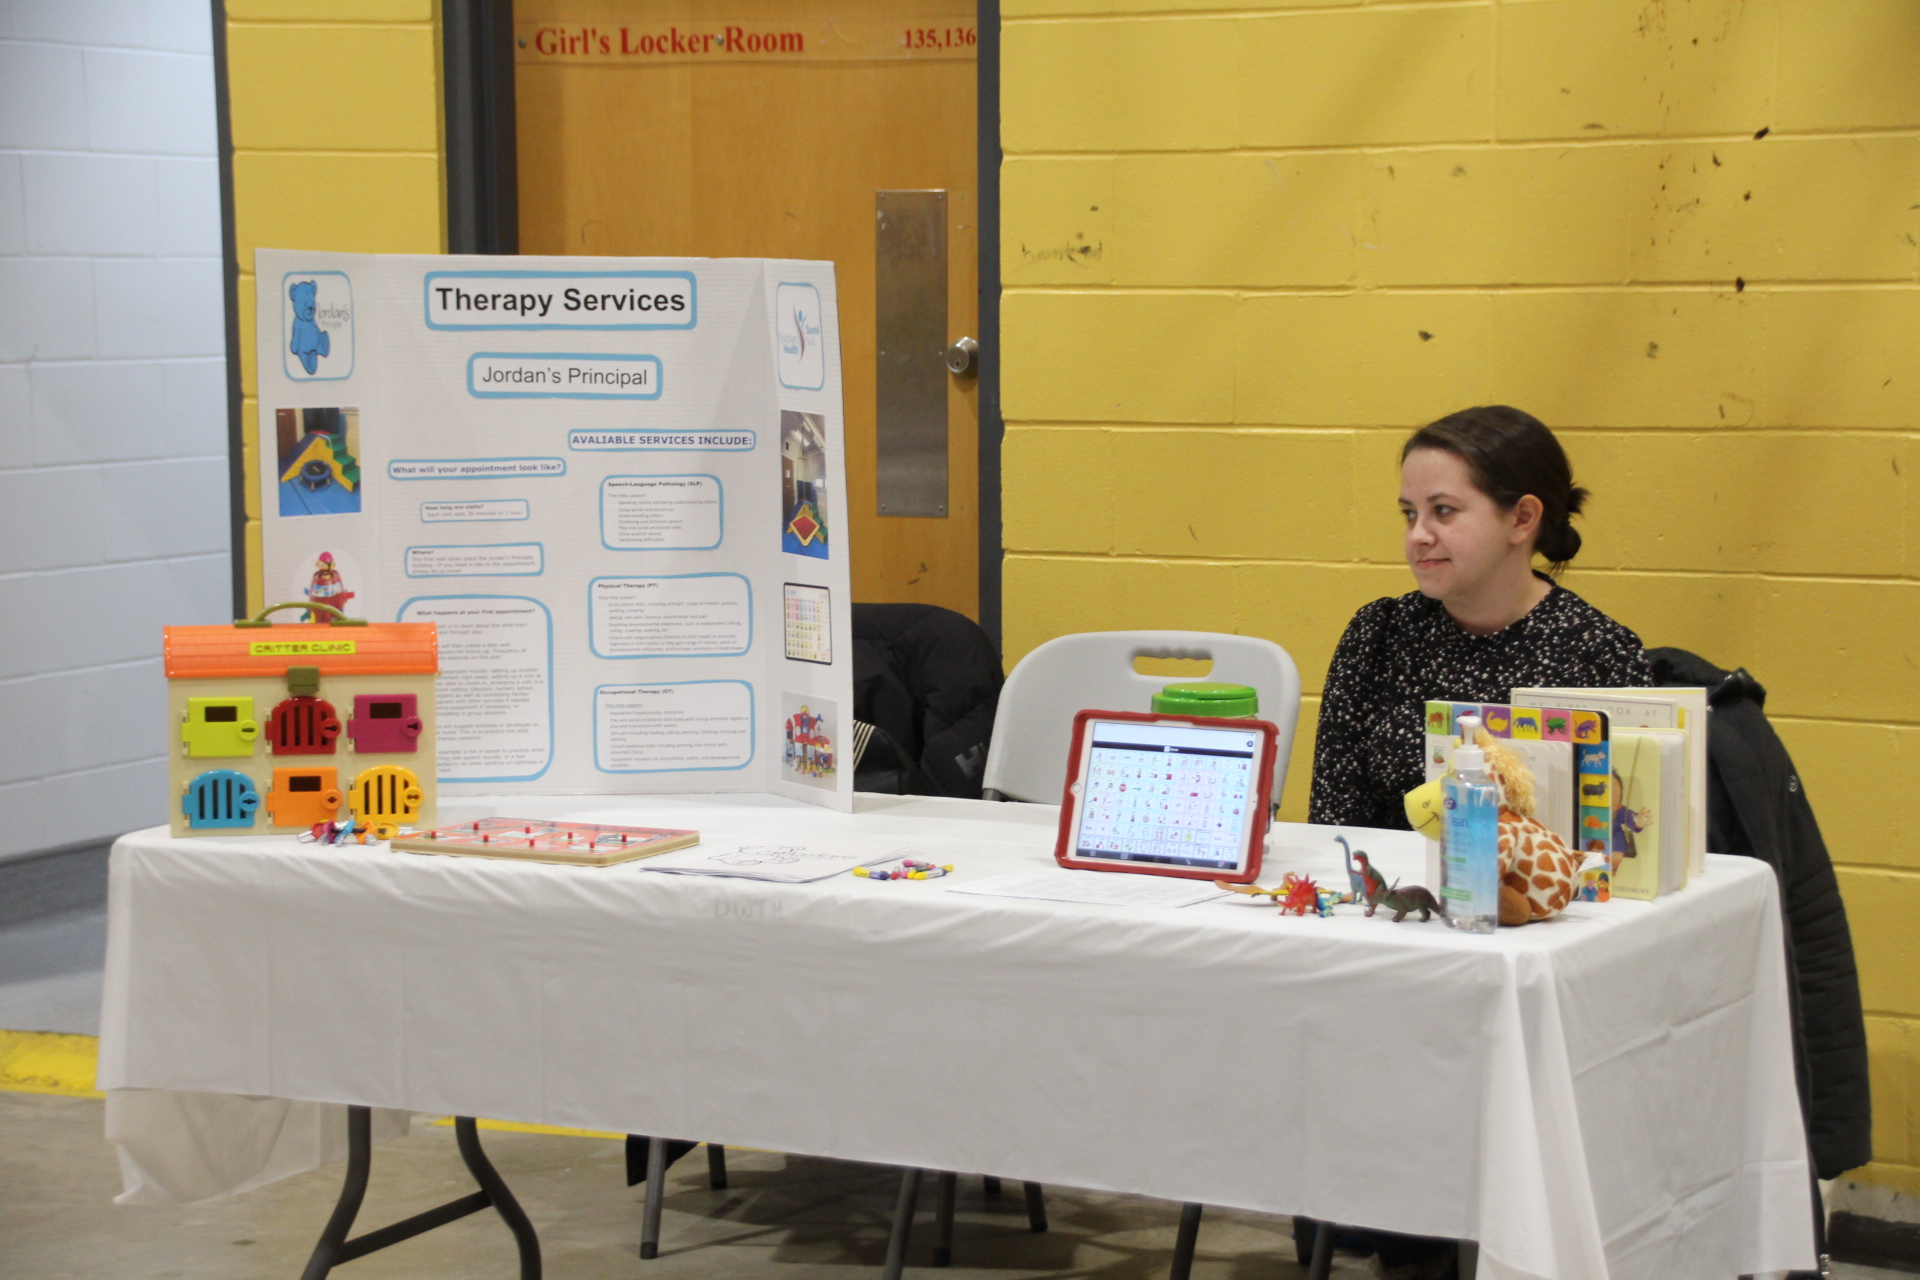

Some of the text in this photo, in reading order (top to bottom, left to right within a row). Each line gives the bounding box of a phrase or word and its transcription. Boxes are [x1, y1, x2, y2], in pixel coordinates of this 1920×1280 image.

[536, 26, 977, 55] Girl's Locker Room 135,136
[435, 287, 685, 317] Therapy Services
[482, 366, 647, 388] Jordan's Principal
[572, 435, 753, 446] AVALIABLE SERVICES INCLUDE:
[392, 466, 416, 474] What
[437, 467, 457, 475] your
[460, 465, 517, 475] appointment
[541, 463, 562, 471] like?
[254, 643, 351, 653] CRITTER CLINIC
